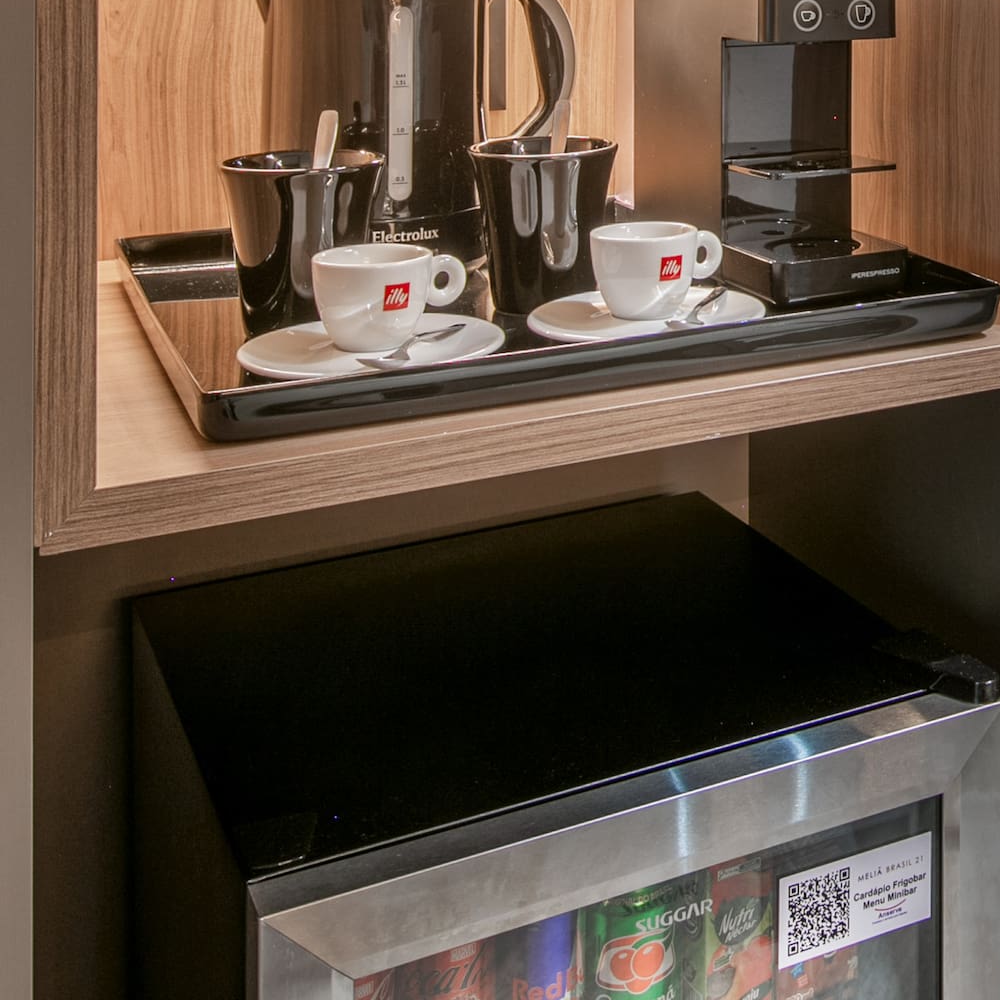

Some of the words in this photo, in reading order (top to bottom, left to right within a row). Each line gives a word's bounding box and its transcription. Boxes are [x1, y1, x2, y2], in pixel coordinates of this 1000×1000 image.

[372, 226, 439, 243] Electrolux
[661, 259, 681, 279] illy
[385, 287, 409, 307] illy
[885, 860, 912, 874] BRASIL
[915, 855, 924, 865] 21
[853, 883, 891, 902] Cardápio
[892, 872, 927, 889] Frigobar
[863, 897, 886, 910] Menu
[887, 886, 918, 902] Minibar
[635, 898, 714, 933] SUGGAR
[718, 905, 757, 937] Nutri
[512, 971, 563, 1000] Red
